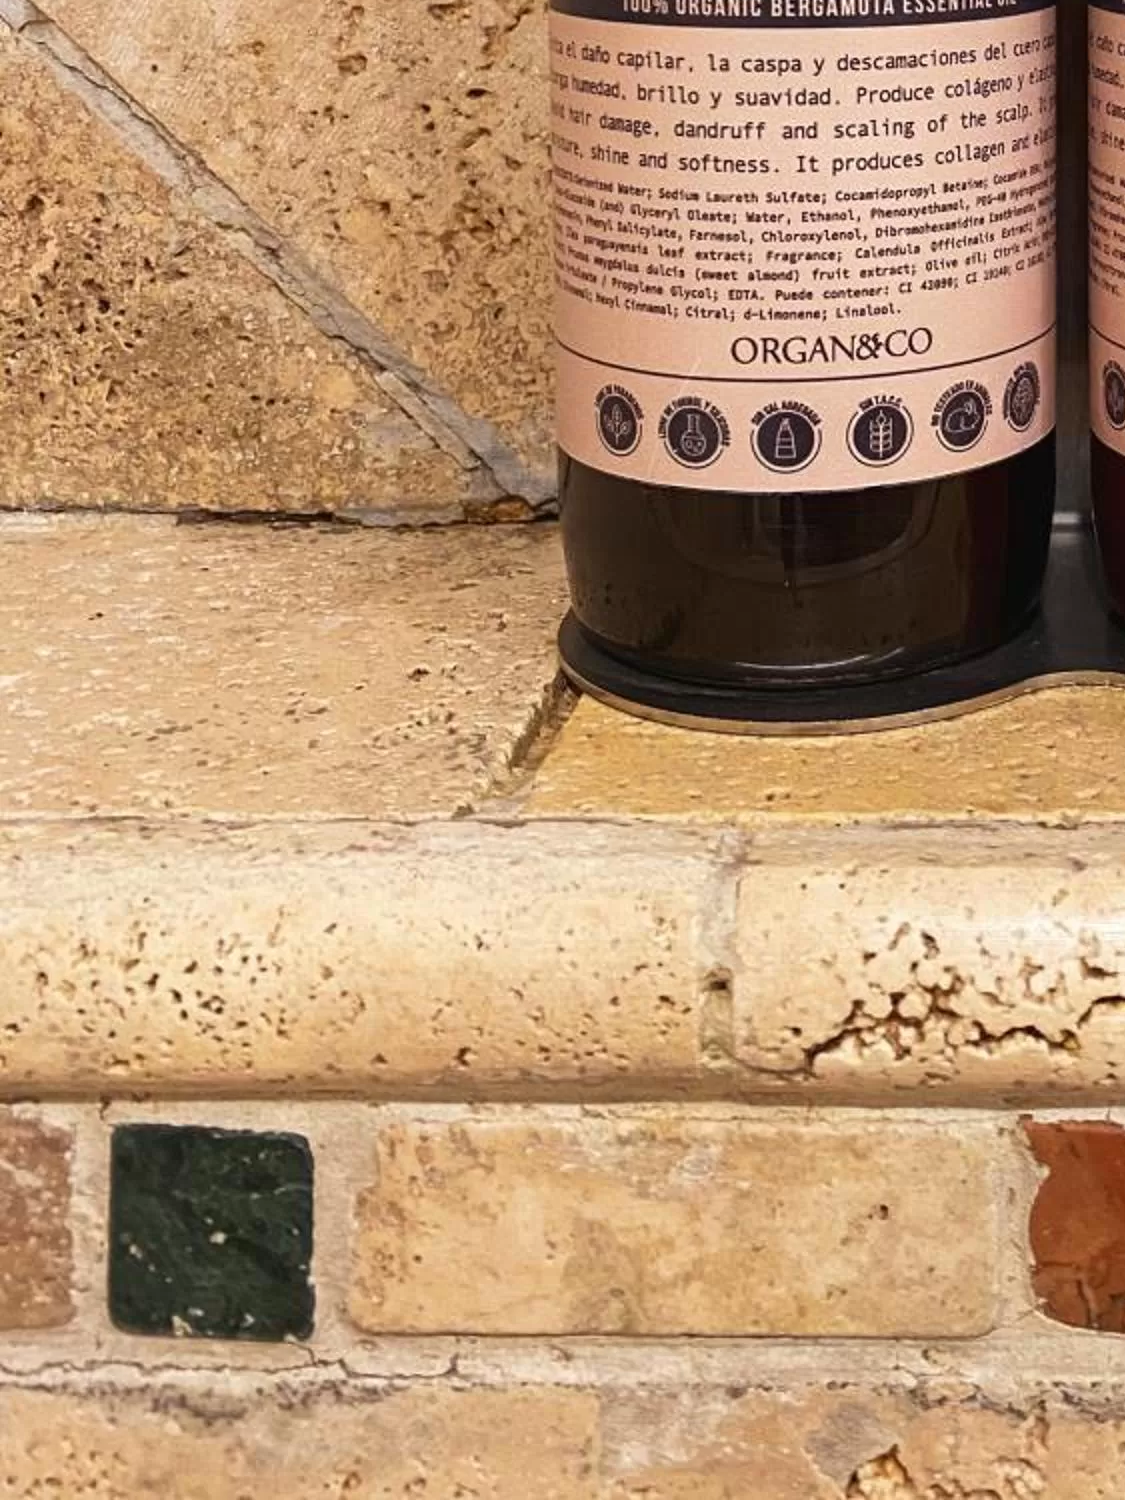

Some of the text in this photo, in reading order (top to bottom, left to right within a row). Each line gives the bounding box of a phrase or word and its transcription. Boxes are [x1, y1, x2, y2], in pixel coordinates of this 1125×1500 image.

[581, 44, 610, 63] daño
[617, 49, 694, 73] capilar,
[708, 54, 730, 72] la
[741, 57, 802, 76] caspa
[813, 58, 824, 76] y
[837, 48, 976, 71] descamaciones
[984, 42, 1006, 61] del
[637, 84, 699, 104] brillo
[710, 91, 722, 109] y
[735, 88, 841, 107] suavidad.
[856, 85, 934, 103] Produce
[945, 76, 1012, 99] colágeno
[1017, 75, 1025, 92] y
[599, 115, 659, 138] damage,
[674, 120, 766, 139] dandruff
[782, 123, 818, 140] and
[833, 118, 915, 139] scaling
[927, 114, 948, 133] of
[961, 112, 987, 129] the
[996, 104, 1033, 125] scalp.
[591, 145, 629, 164] shine
[639, 152, 667, 169] and
[679, 154, 780, 173] softness.
[796, 155, 819, 173] It
[832, 152, 923, 175] produces
[935, 142, 1005, 165] collagen
[659, 189, 699, 201] Sodium
[835, 184, 936, 202] Cocamidopropyl
[630, 205, 680, 220] Glyceryl
[689, 230, 754, 245] Farnesol,
[659, 244, 684, 258] leaf
[766, 250, 843, 265] Fragrance;
[855, 244, 920, 259] Calendula
[812, 267, 850, 281] fruit
[860, 263, 917, 279] extract;
[925, 257, 958, 272] Olive
[728, 289, 764, 300] EDTA.
[775, 289, 813, 300] Puede
[898, 283, 912, 293] CI
[744, 307, 827, 320] d-Limonene;
[836, 303, 901, 319] Linalool.
[730, 327, 933, 365] ORGAN&CO
